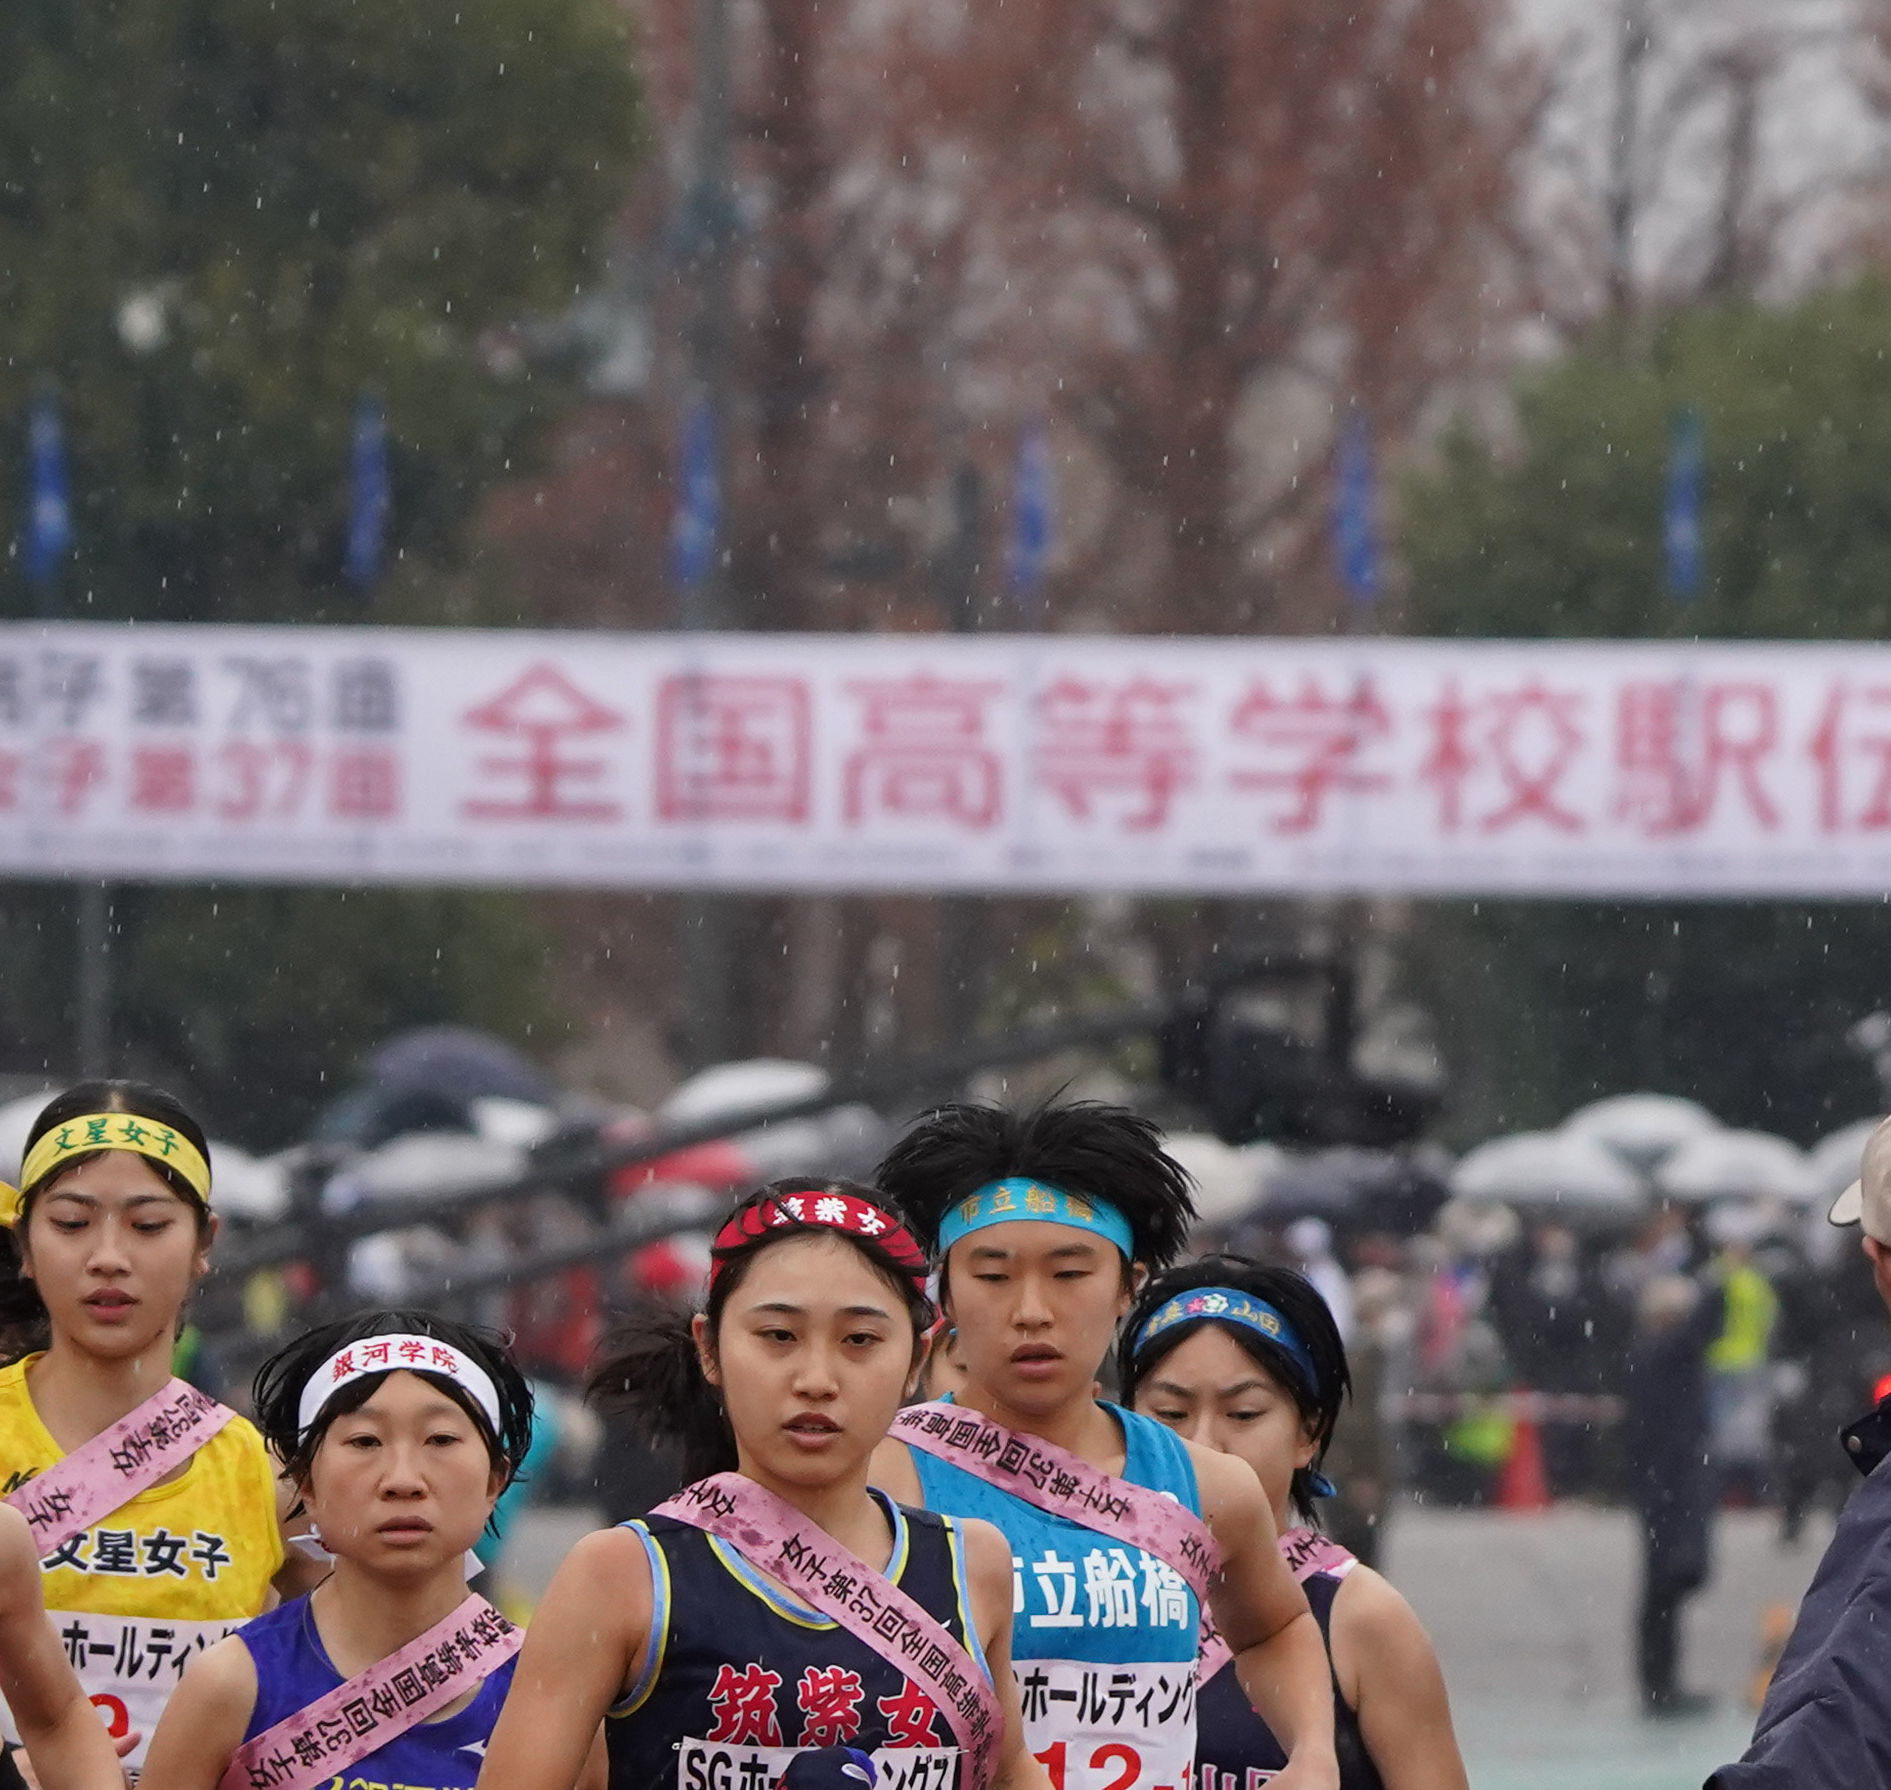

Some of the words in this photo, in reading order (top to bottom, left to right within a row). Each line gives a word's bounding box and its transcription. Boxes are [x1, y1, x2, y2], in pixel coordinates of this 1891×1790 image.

[53, 1118, 181, 1156] 文星女子
[958, 1186, 1095, 1224] 市立船橋
[331, 1340, 460, 1383] 銀河学院
[43, 1529, 233, 1580] 文星女子
[708, 1663, 942, 1748] 筑紫女
